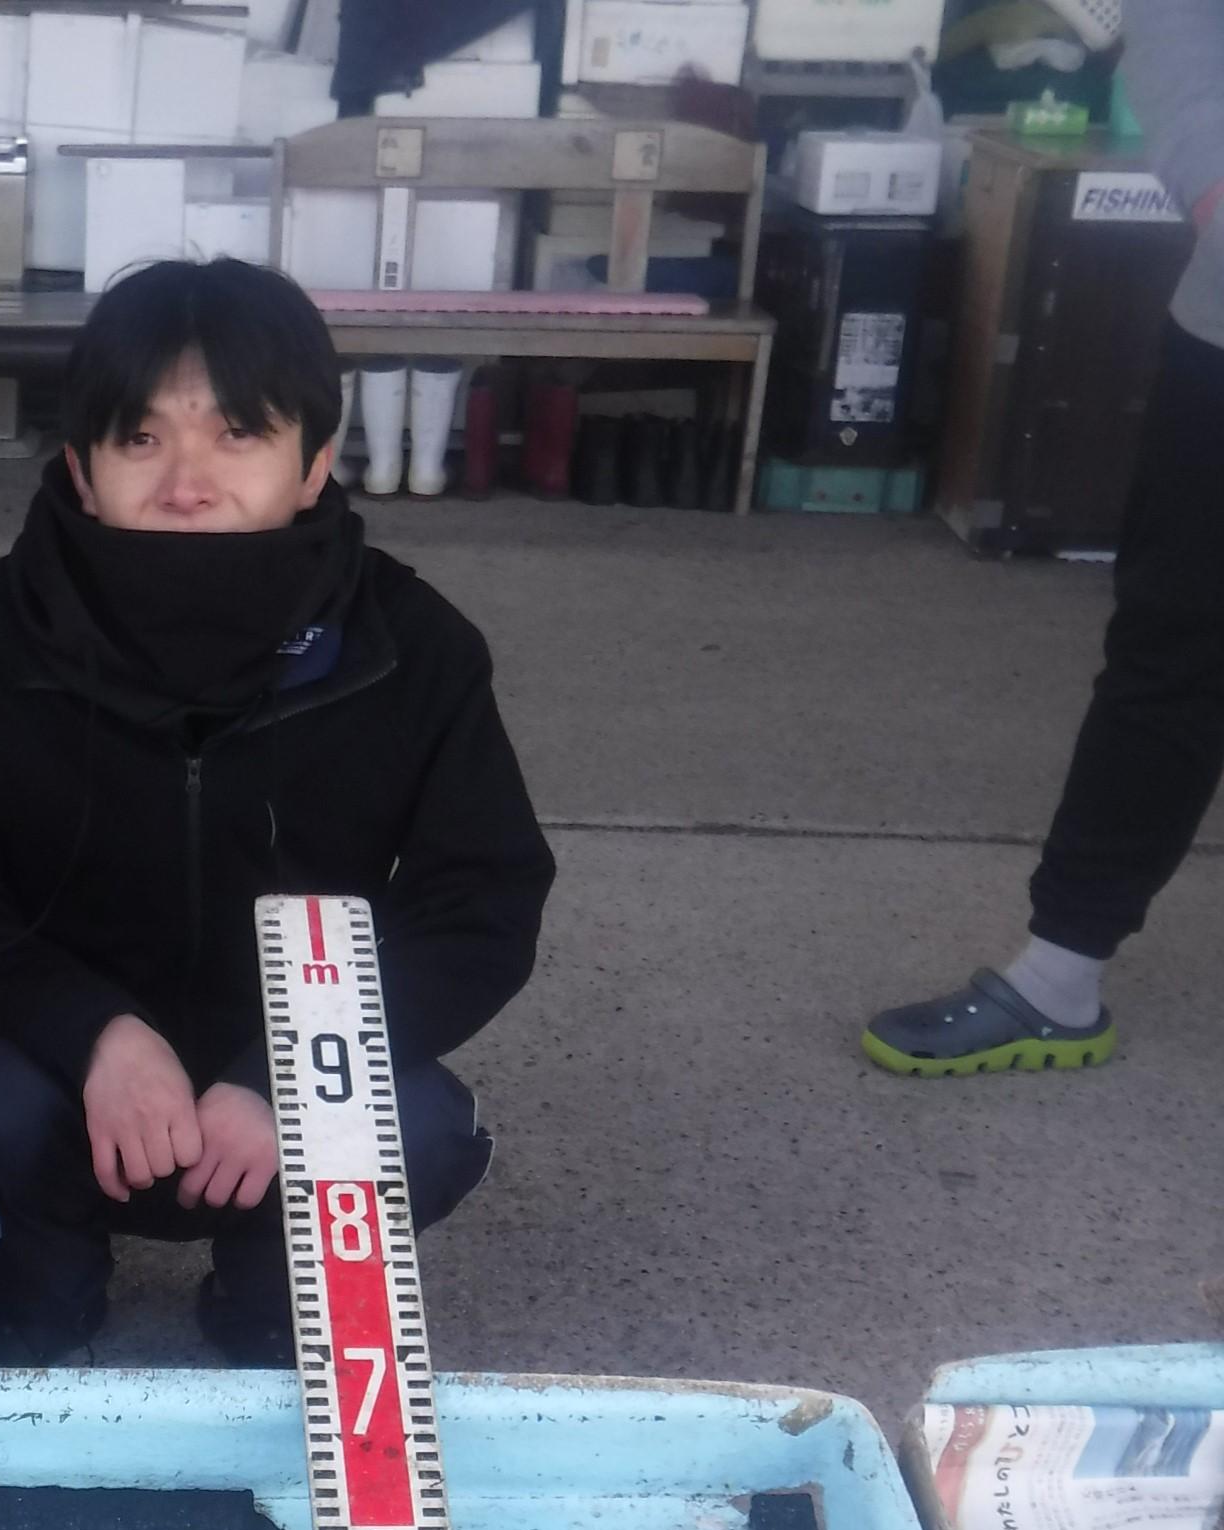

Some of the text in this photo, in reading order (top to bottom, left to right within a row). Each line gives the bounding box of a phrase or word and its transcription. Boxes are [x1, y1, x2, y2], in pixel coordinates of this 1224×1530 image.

[1082, 188, 1174, 213] FISHIN
[302, 961, 340, 985] m
[311, 1033, 354, 1103] 9
[326, 1182, 373, 1262] 8
[343, 1347, 387, 1435] 7
